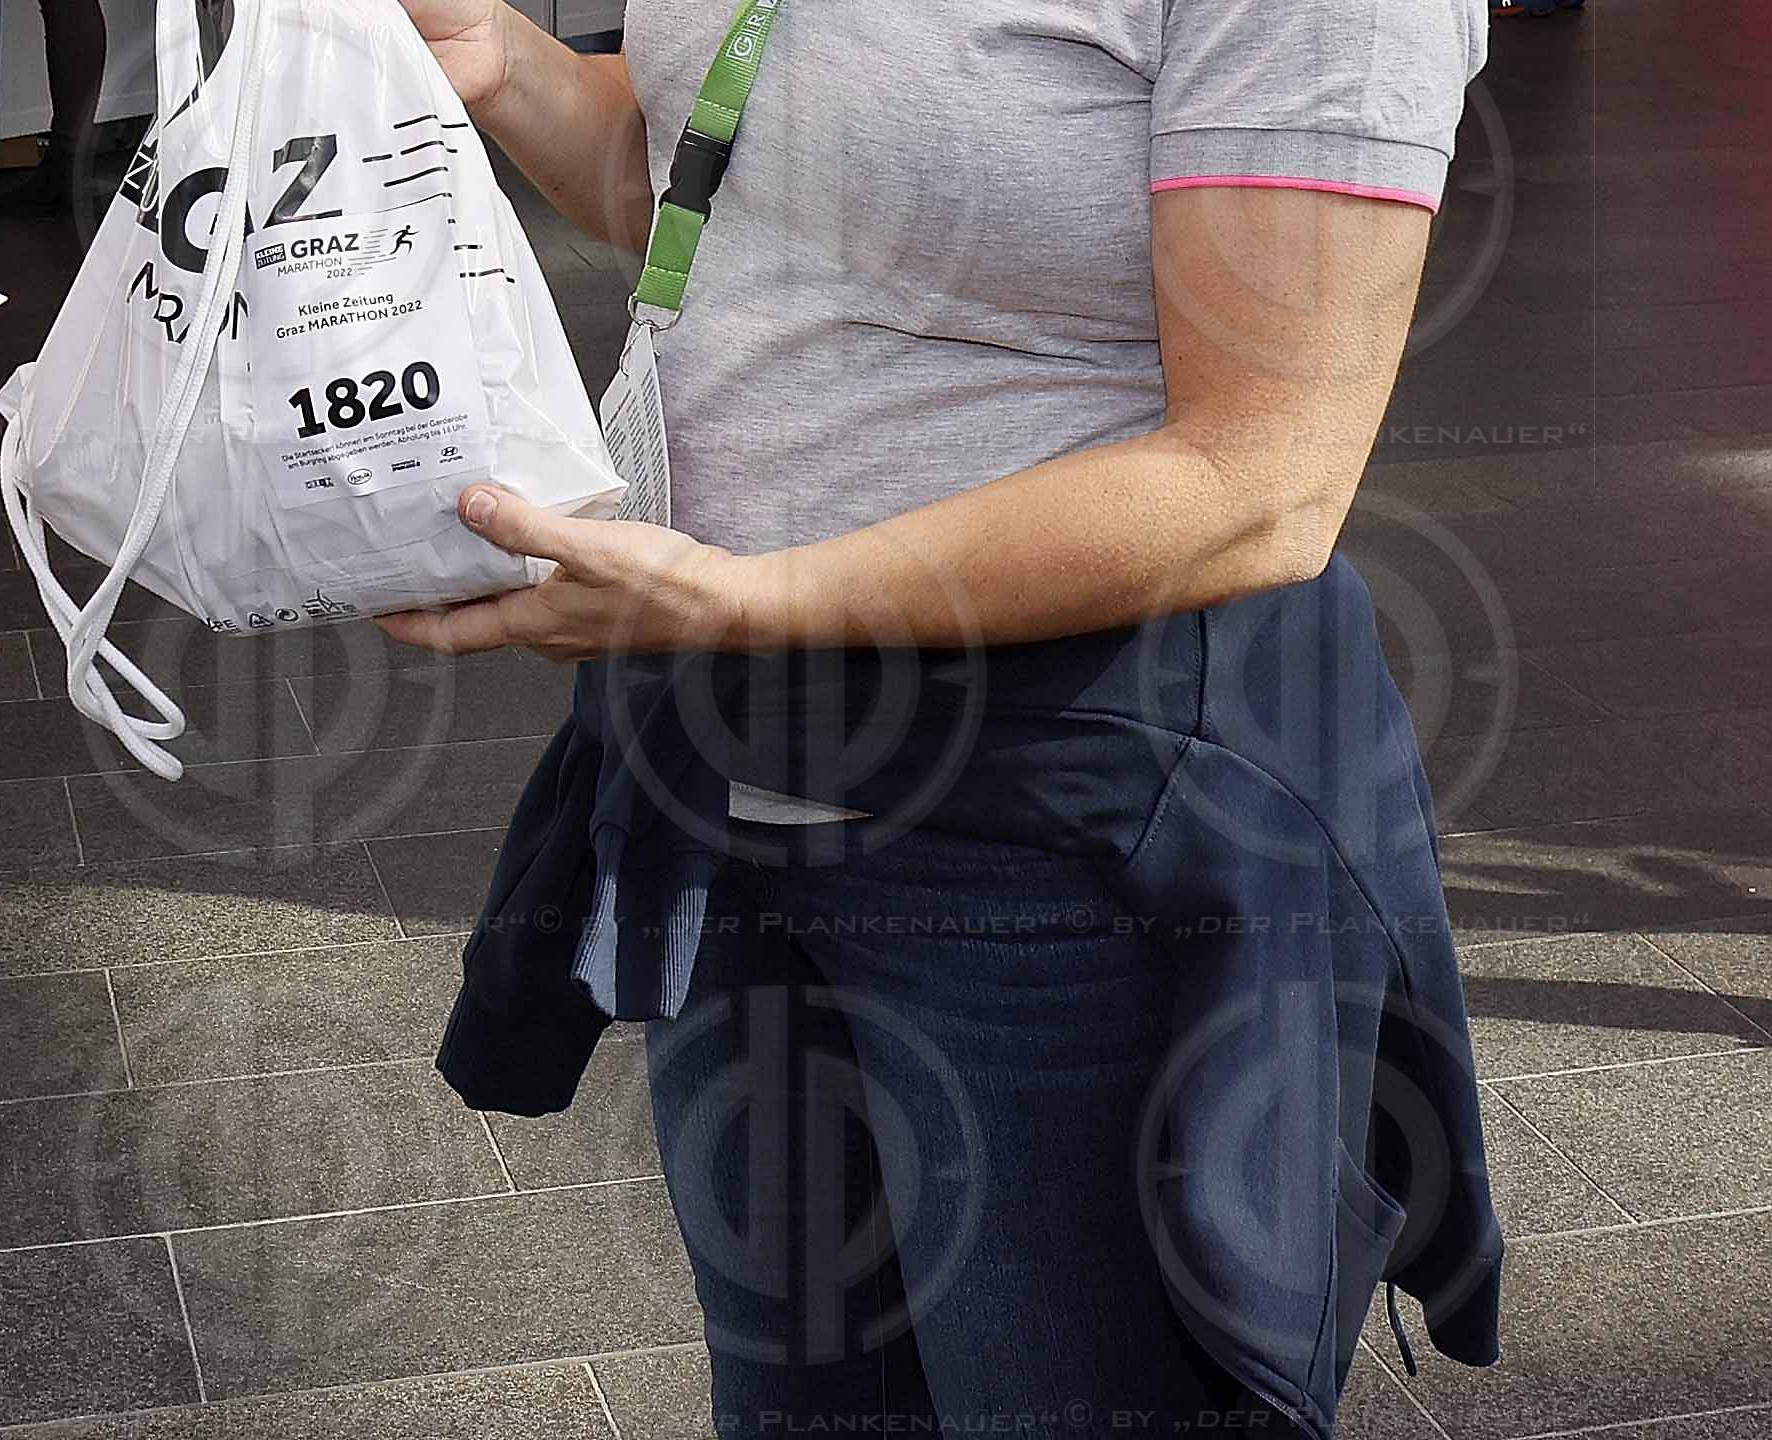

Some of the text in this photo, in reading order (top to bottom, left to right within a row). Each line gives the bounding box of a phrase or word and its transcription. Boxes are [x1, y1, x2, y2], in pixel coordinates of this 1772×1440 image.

[255, 244, 284, 259] KLEINE
[290, 233, 359, 259] GRAZ
[277, 257, 343, 278] MARATHON
[326, 267, 353, 279] 2022
[297, 293, 395, 317] Kleine Zeitung
[276, 300, 423, 339] Graz MARATHON 2022
[288, 361, 441, 440] 1820
[374, 427, 406, 442] Sonntag
[406, 424, 416, 434] bei
[417, 422, 428, 431] der
[429, 414, 469, 428] Garderobe
[397, 431, 430, 445] Abholung
